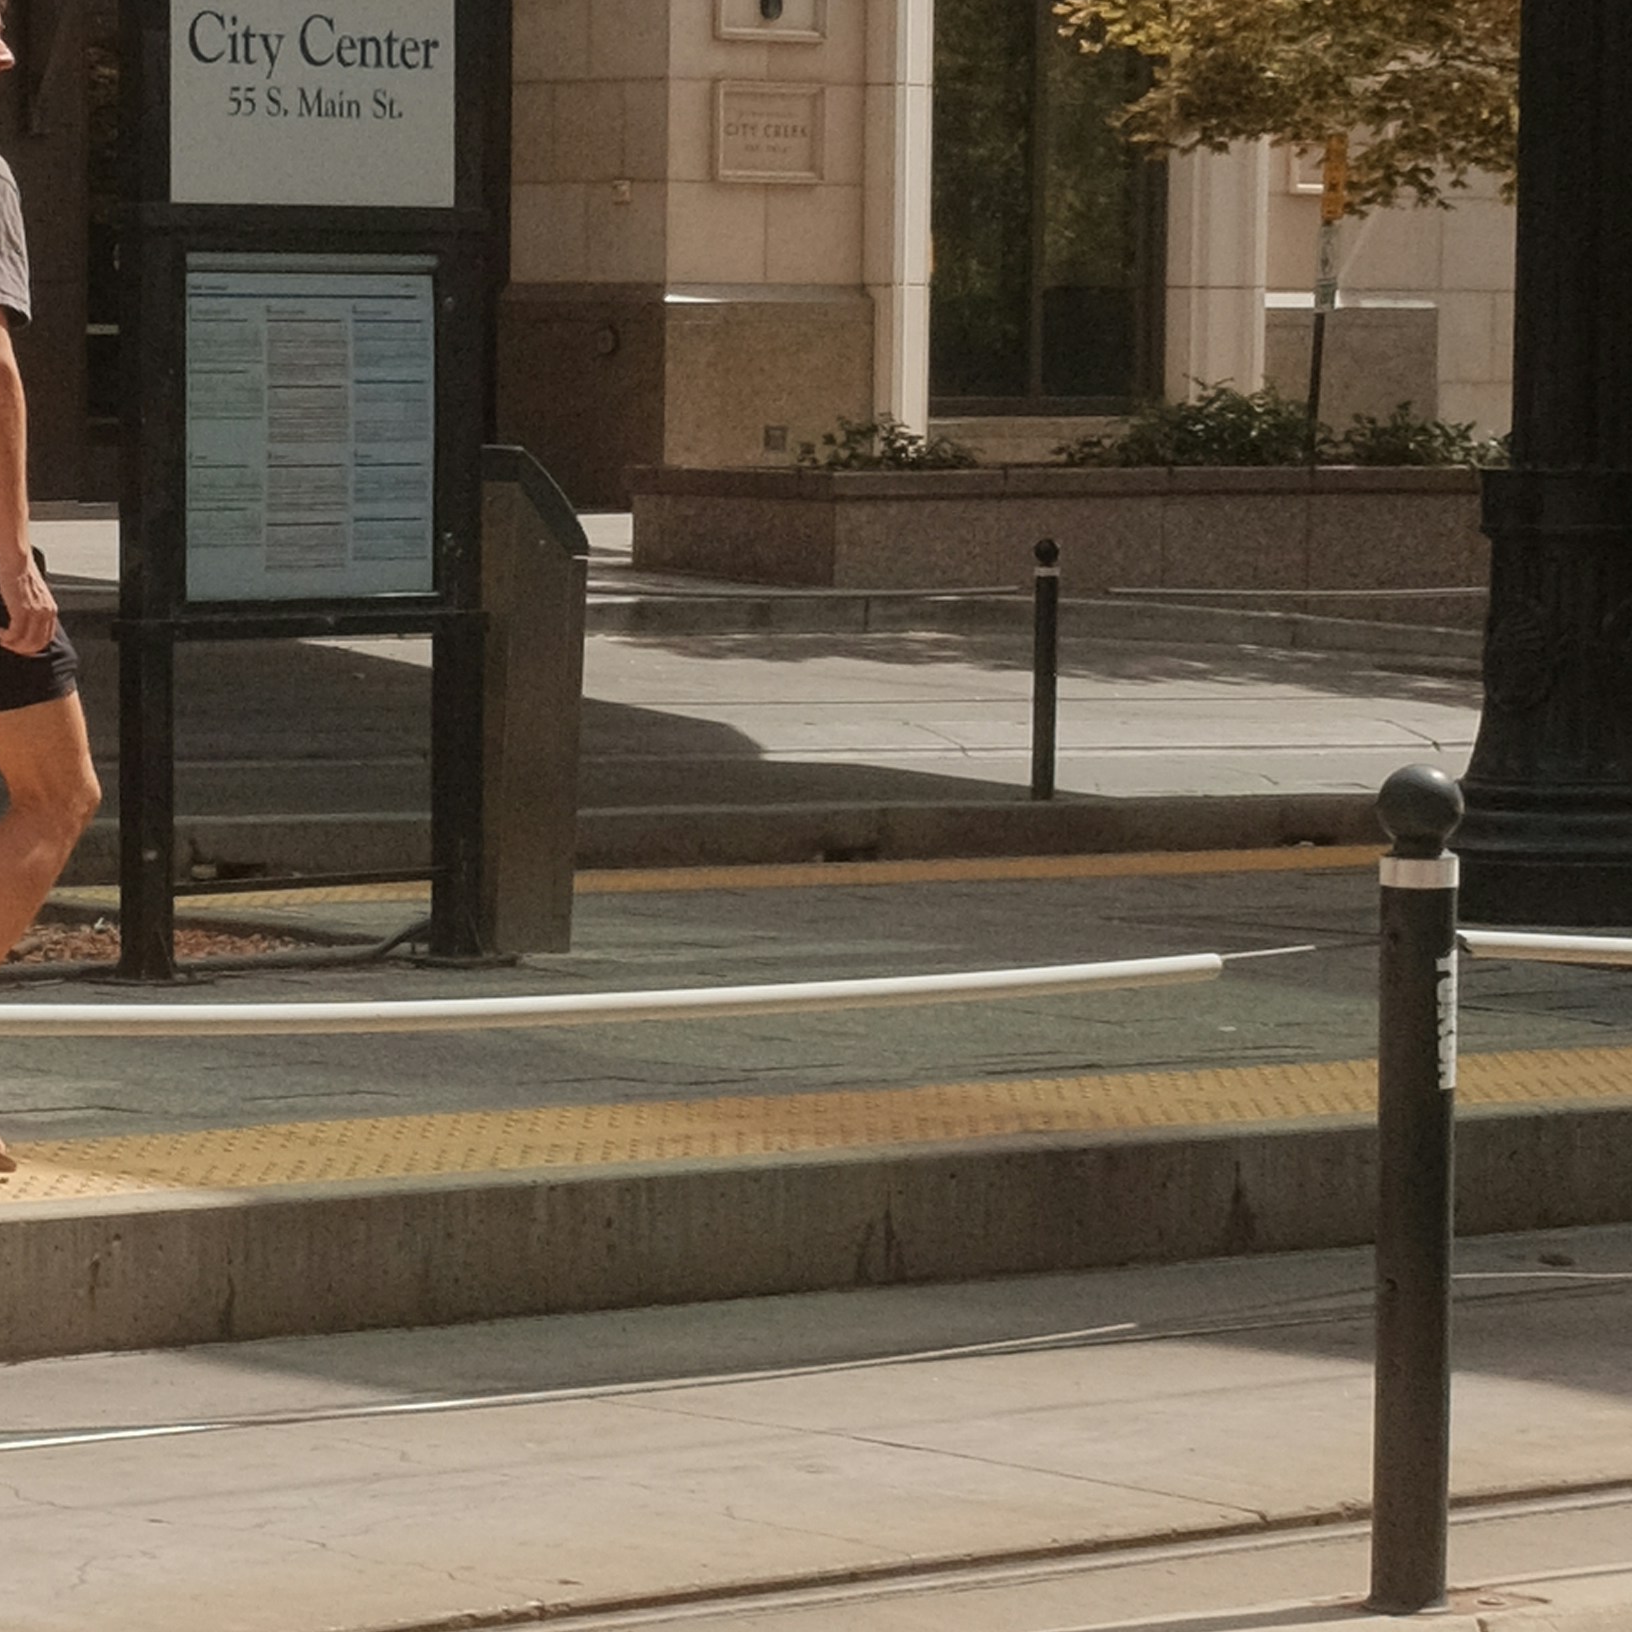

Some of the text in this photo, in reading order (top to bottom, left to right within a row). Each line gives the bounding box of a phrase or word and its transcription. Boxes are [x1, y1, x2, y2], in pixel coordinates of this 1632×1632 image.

[188, 10, 440, 79] City Center
[227, 86, 403, 119] 55 S. Main St.
